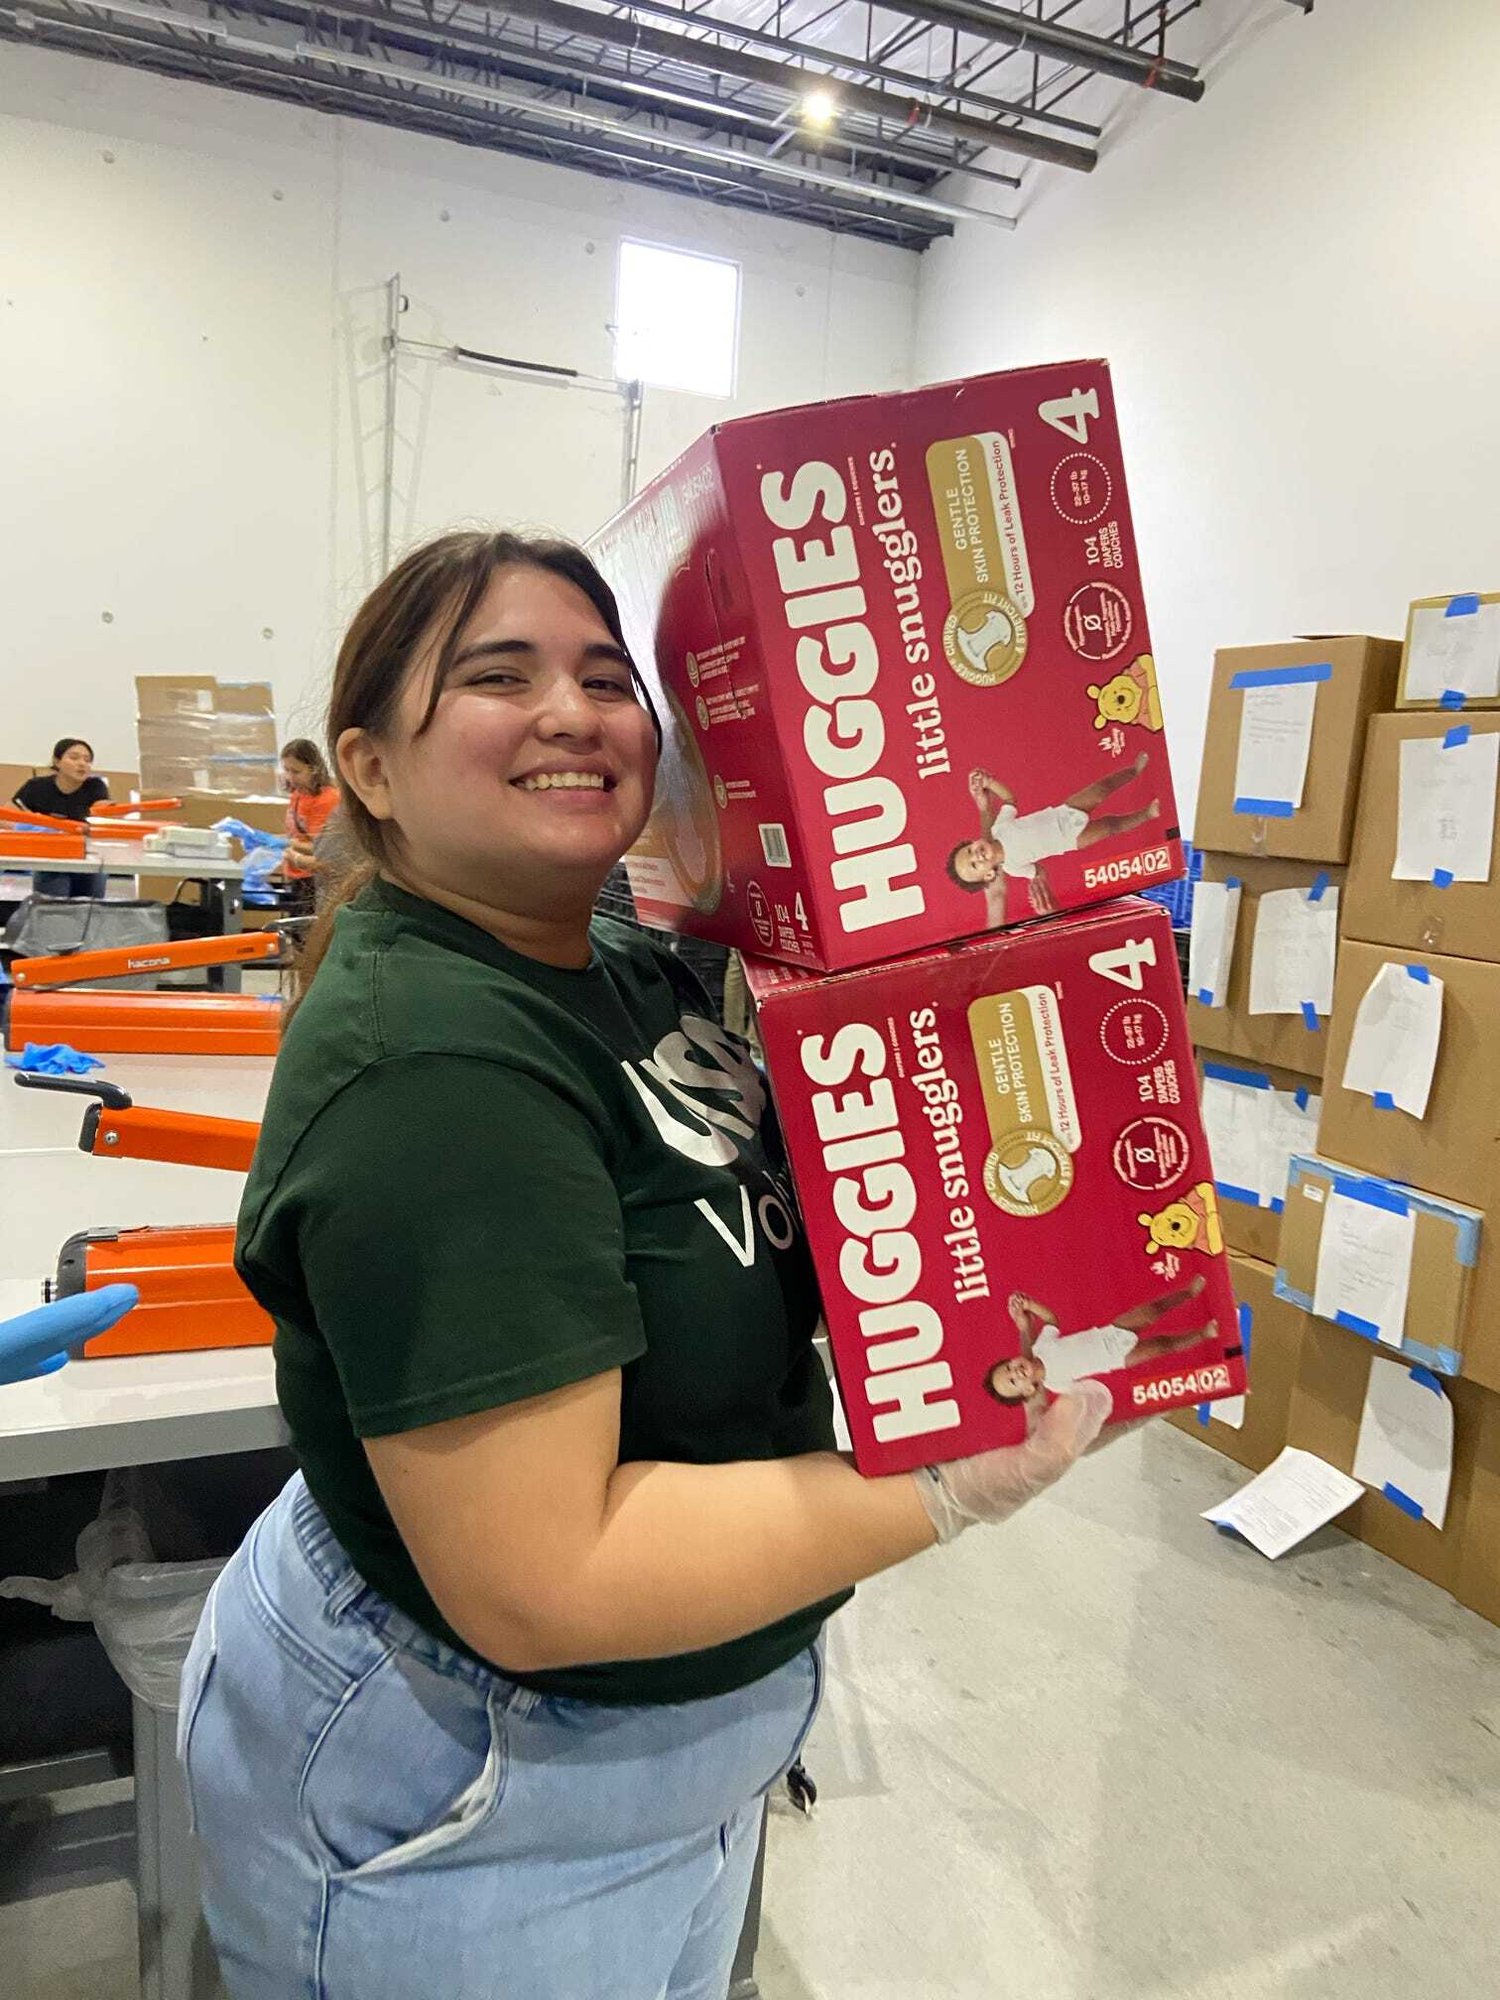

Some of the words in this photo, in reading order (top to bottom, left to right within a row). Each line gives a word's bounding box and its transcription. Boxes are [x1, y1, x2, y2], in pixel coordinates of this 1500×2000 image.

[1038, 387, 1100, 445] 4
[992, 440, 1010, 503] Protection
[955, 448, 984, 542] PROTECTION
[1000, 503, 1013, 529] Leak
[946, 486, 968, 551] GENTLE
[1005, 529, 1015, 547] of
[869, 447, 930, 665] snugglers
[969, 542, 989, 584] SKIN
[1010, 547, 1024, 579] Hours
[1084, 537, 1099, 566] 104
[1099, 527, 1113, 569] DIAPERS
[1107, 520, 1124, 570] COUCHES
[1014, 580, 1025, 596] 12
[760, 459, 926, 934] HUGGIES
[905, 672, 951, 781] little
[1084, 857, 1142, 890] 54054
[1145, 848, 1169, 872] 02
[795, 892, 809, 932] 4
[1088, 937, 1156, 990] 4
[1037, 992, 1054, 1051] Protection
[999, 1002, 1026, 1088] PROTECTION
[1048, 1051, 1061, 1074] Leak
[989, 1038, 1009, 1095] GENTLE
[1052, 1074, 1063, 1088] of
[1153, 1066, 1168, 1104] DIAPERS
[1164, 1060, 1180, 1104] COUCHES
[909, 1007, 970, 1200] snugglers
[1012, 1088, 1032, 1124] SKIN
[1053, 1089, 1069, 1118] Hours
[1137, 1075, 1154, 1102] 104
[1060, 1117, 1070, 1132] 12
[800, 1021, 962, 1444] HUGGIES
[944, 1204, 990, 1304] little
[1132, 1374, 1197, 1405] 54054
[1200, 1367, 1228, 1392] 02
